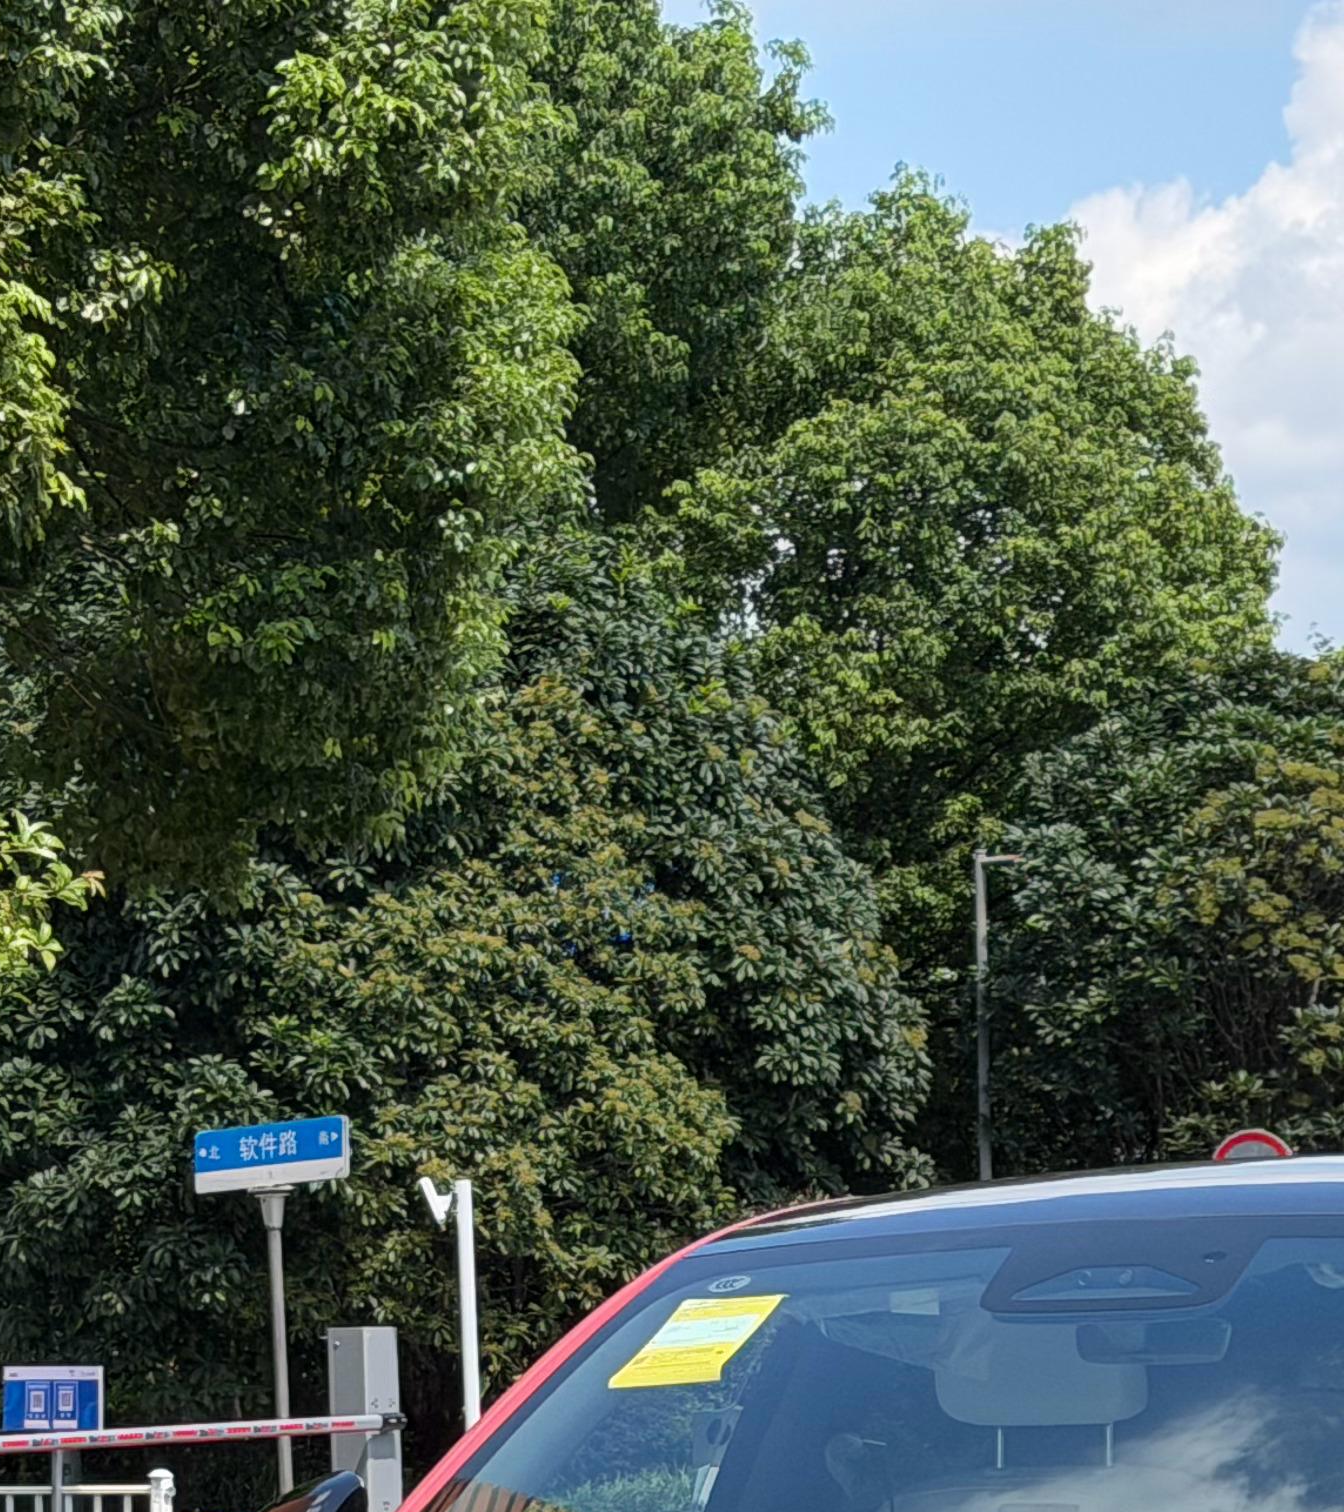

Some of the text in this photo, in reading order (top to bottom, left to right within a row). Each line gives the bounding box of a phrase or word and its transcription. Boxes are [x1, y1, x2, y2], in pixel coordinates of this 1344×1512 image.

[208, 1145, 221, 1160] 北
[239, 1129, 297, 1161] 软件路
